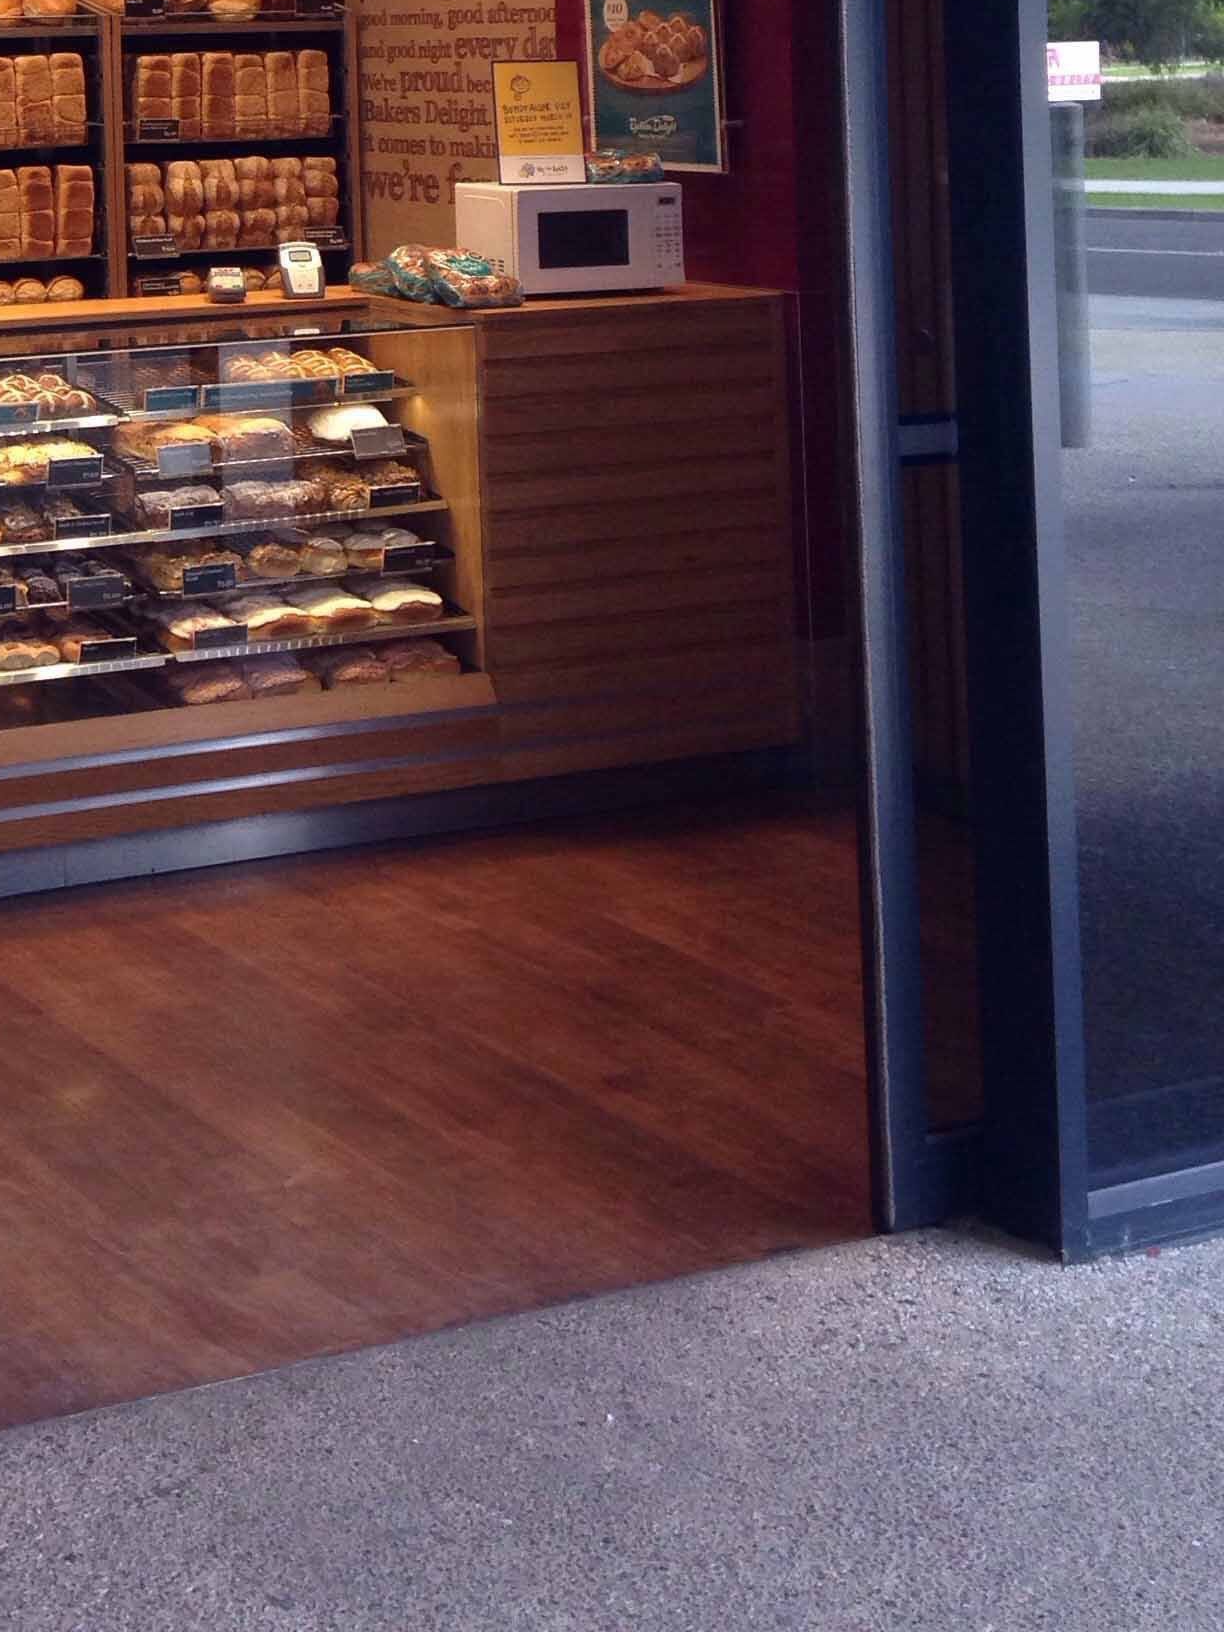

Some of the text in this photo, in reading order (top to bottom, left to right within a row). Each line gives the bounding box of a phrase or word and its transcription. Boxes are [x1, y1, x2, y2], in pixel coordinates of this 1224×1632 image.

[390, 8, 443, 28] morning,
[448, 1, 483, 31] good
[387, 41, 417, 64] good
[419, 40, 452, 64] night
[454, 35, 520, 60] every
[400, 61, 464, 99] proud
[362, 97, 421, 124] Bakers
[424, 99, 492, 133] Delight.
[378, 137, 426, 156] comes
[429, 137, 446, 155] to
[361, 160, 440, 204] we're
